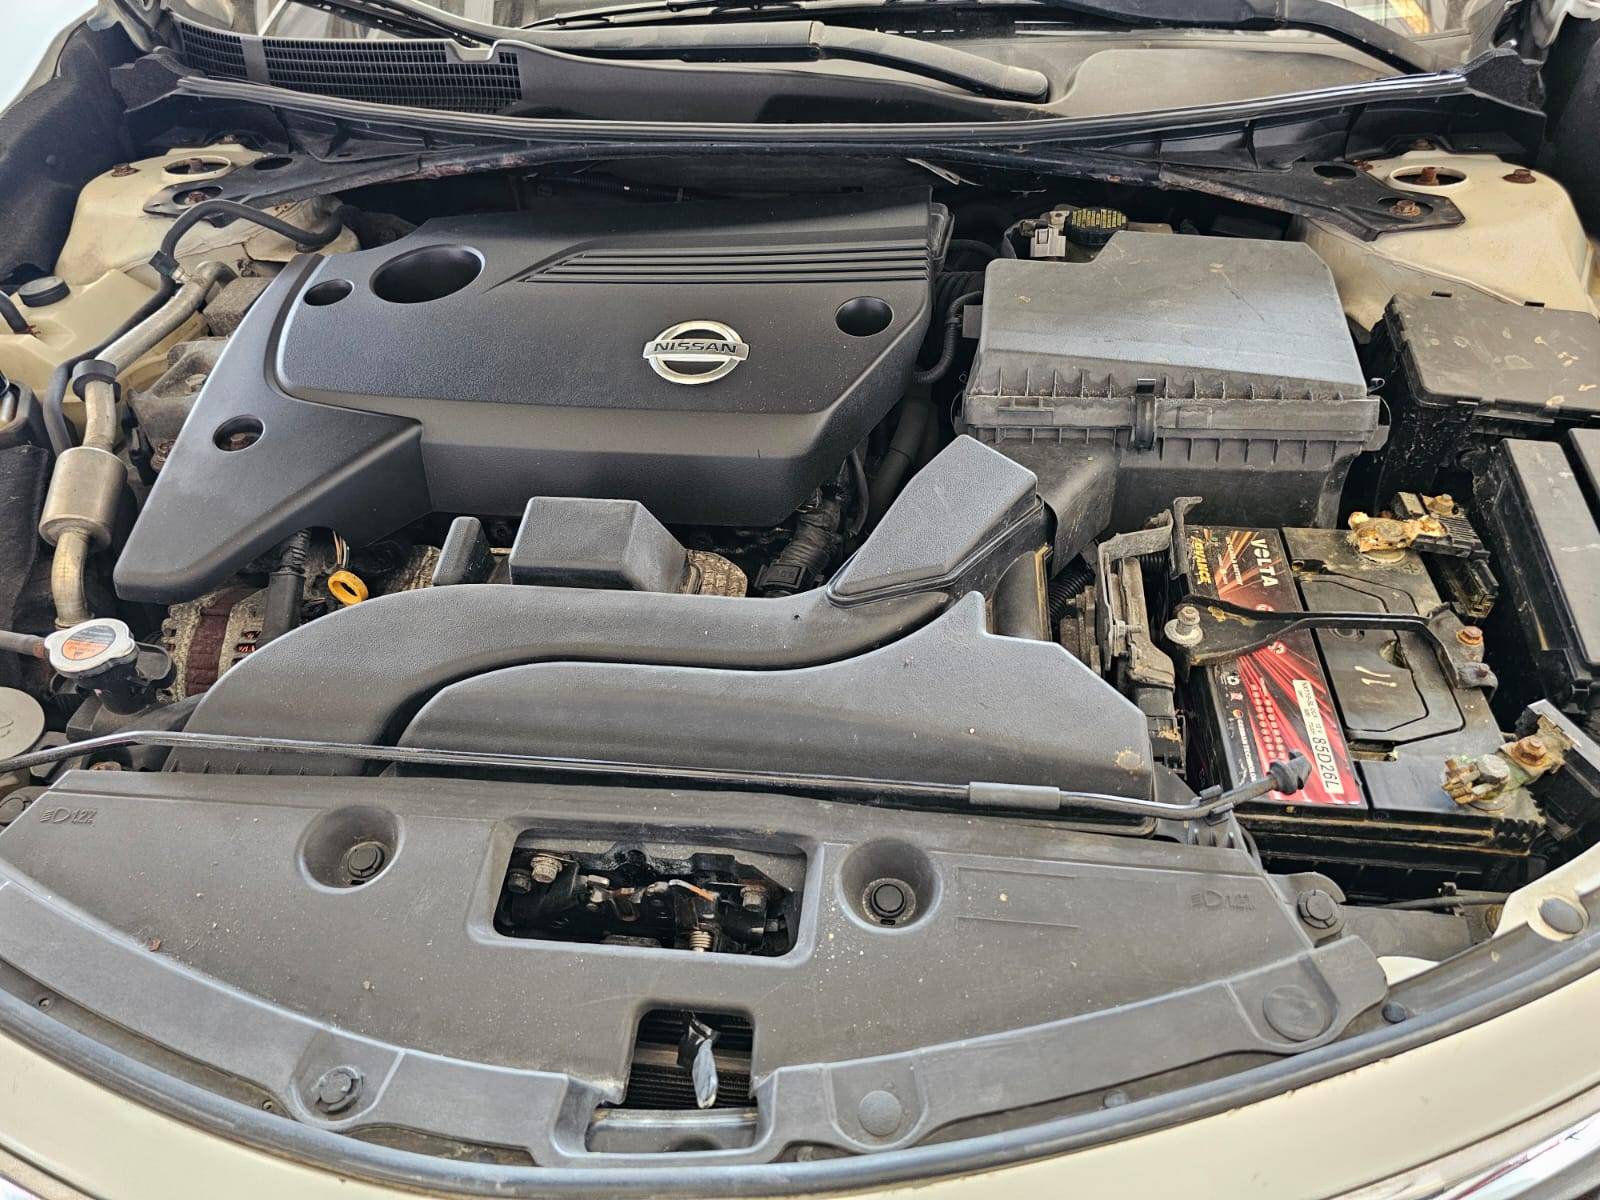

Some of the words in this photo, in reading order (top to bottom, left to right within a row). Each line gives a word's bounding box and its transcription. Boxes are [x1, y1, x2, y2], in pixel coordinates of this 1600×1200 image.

[654, 342, 738, 354] NISSAN
[1251, 539, 1279, 587] VOLTA
[1243, 744, 1257, 782] TECHNOLOG
[1312, 737, 1340, 788] 85D26L
